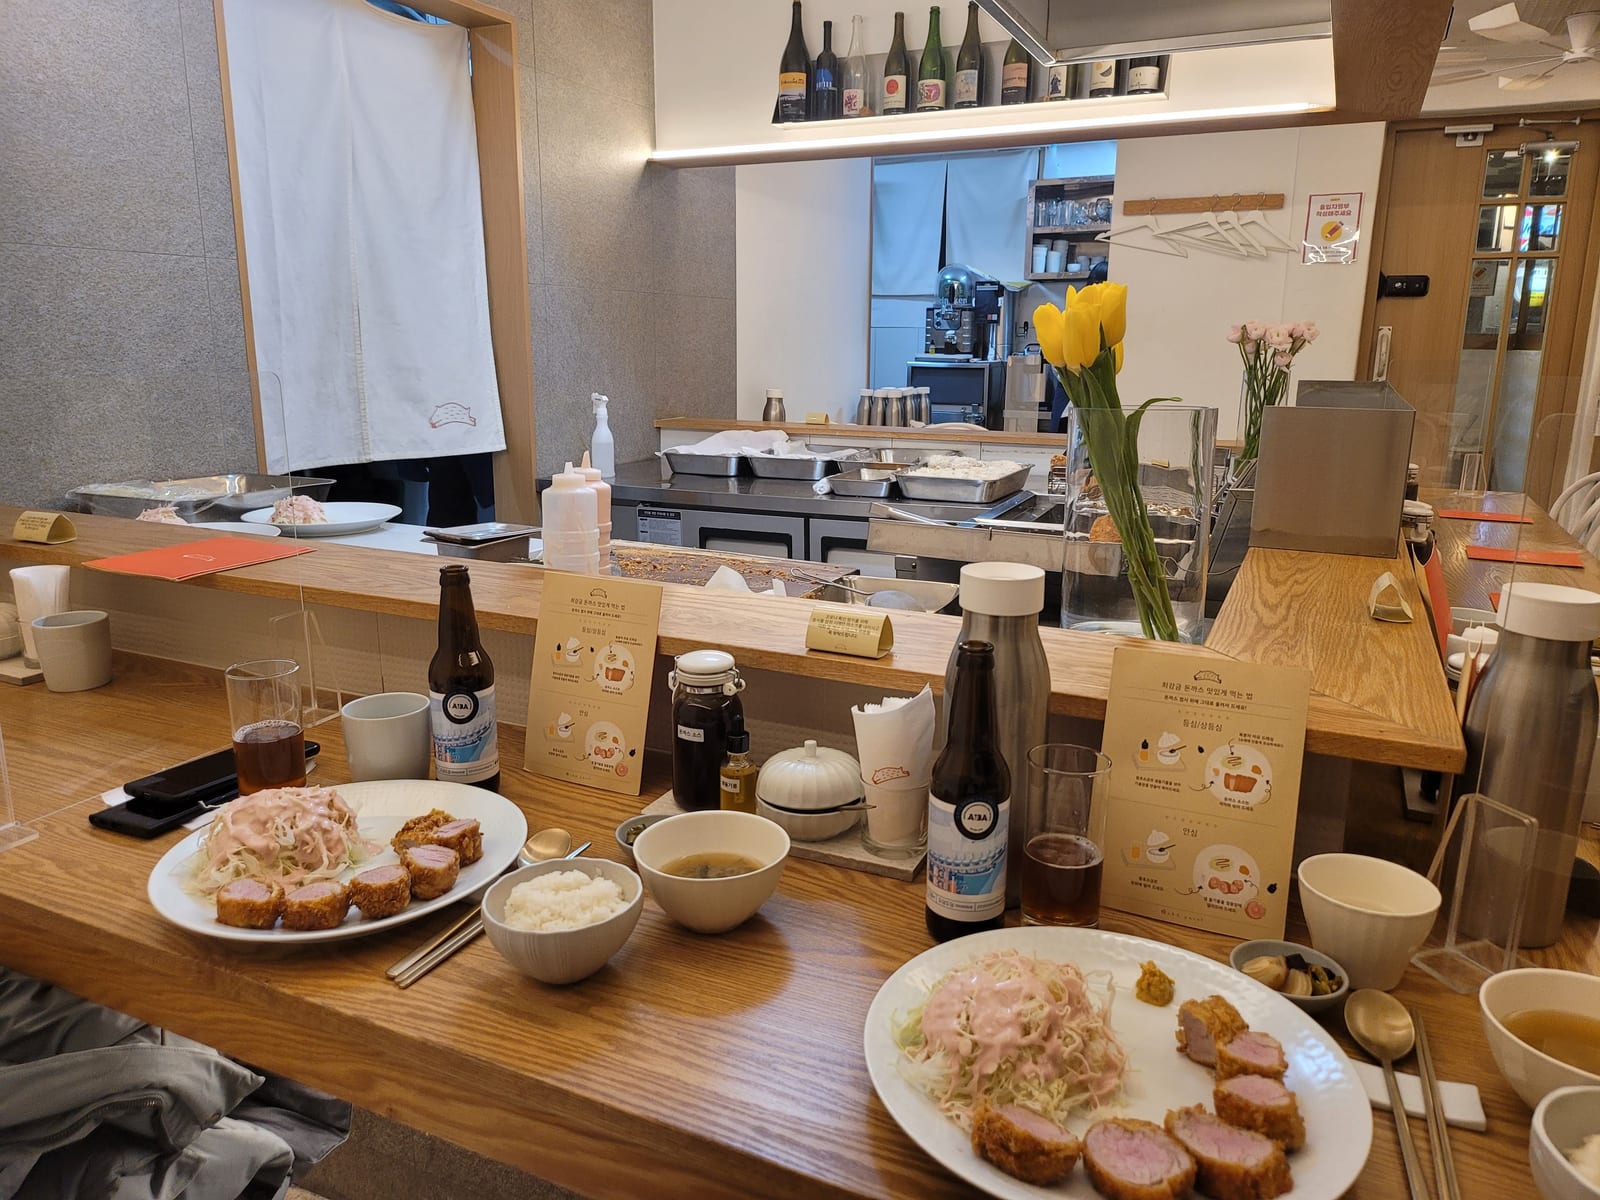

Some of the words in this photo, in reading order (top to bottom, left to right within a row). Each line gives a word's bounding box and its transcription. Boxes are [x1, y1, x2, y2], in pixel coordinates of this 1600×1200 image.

[1162, 681, 1182, 692] 최강금
[1184, 685, 1204, 693] 돈까스
[1206, 687, 1227, 697] 맛있게
[1230, 690, 1243, 698] 먹는
[1246, 692, 1253, 700] 법
[1183, 719, 1223, 732] 등심/상등심
[1182, 827, 1198, 837] 안심
